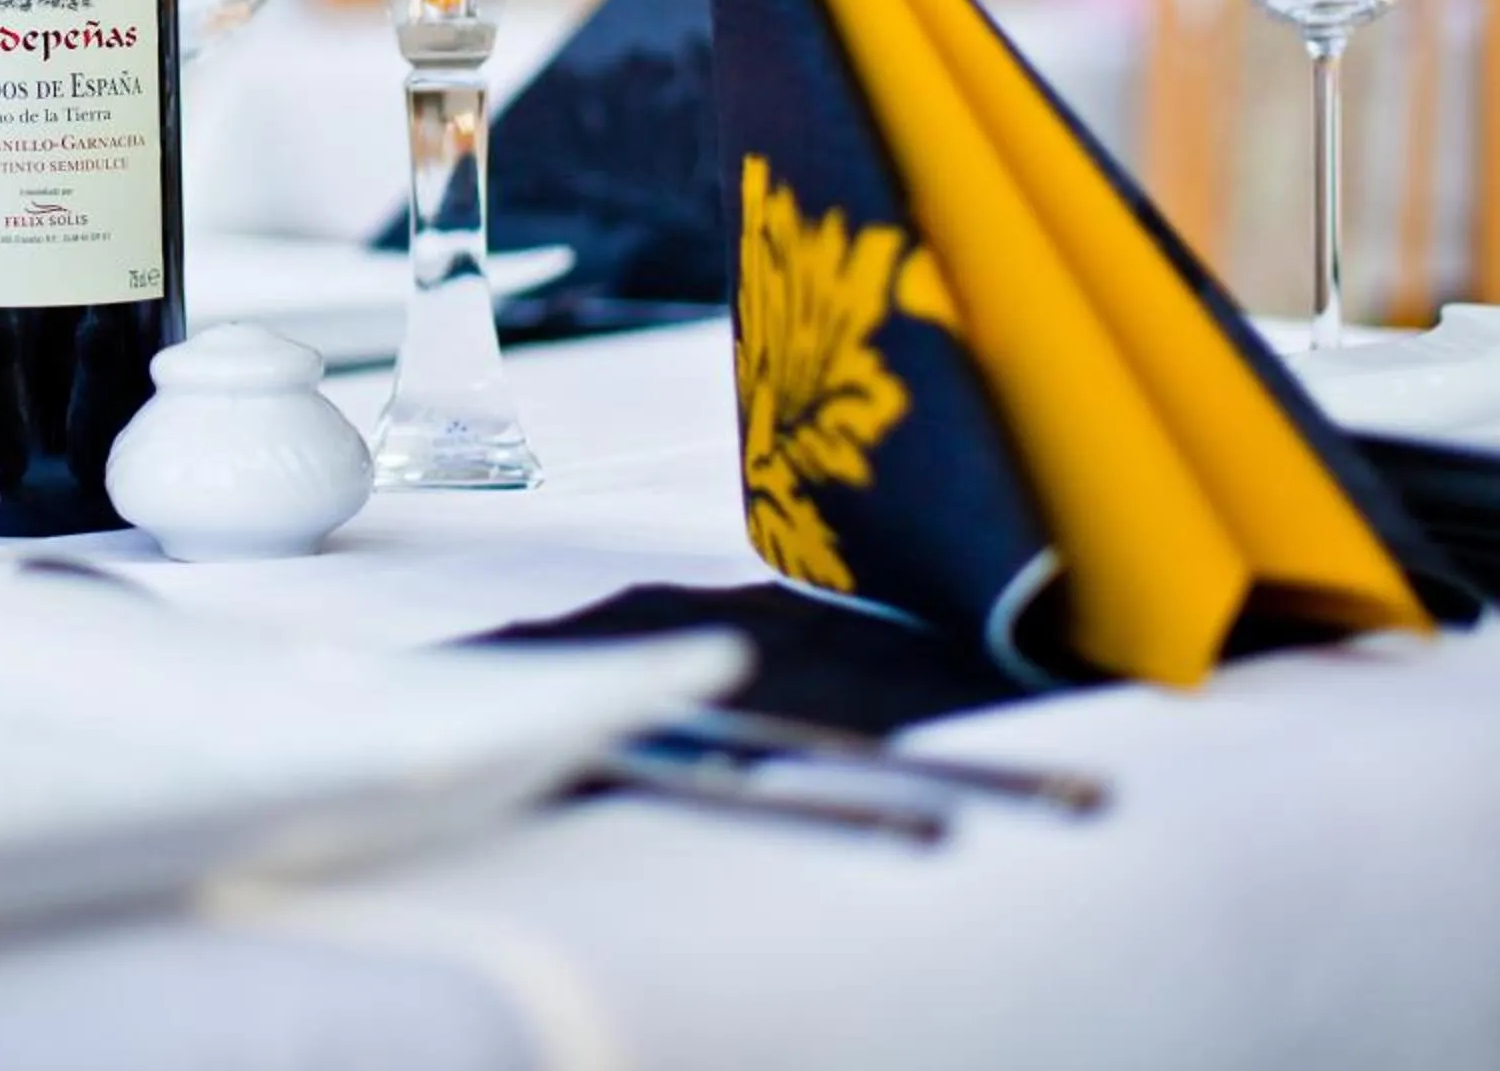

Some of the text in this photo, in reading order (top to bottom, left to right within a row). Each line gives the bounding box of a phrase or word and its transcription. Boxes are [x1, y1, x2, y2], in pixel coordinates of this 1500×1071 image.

[36, 81, 64, 99] DE
[70, 71, 143, 98] ESPAÑA
[19, 109, 39, 123] de
[44, 108, 59, 122] la
[66, 107, 112, 122] Tierra
[1, 159, 45, 173] TINTO
[49, 157, 128, 172] SEMIDULCE
